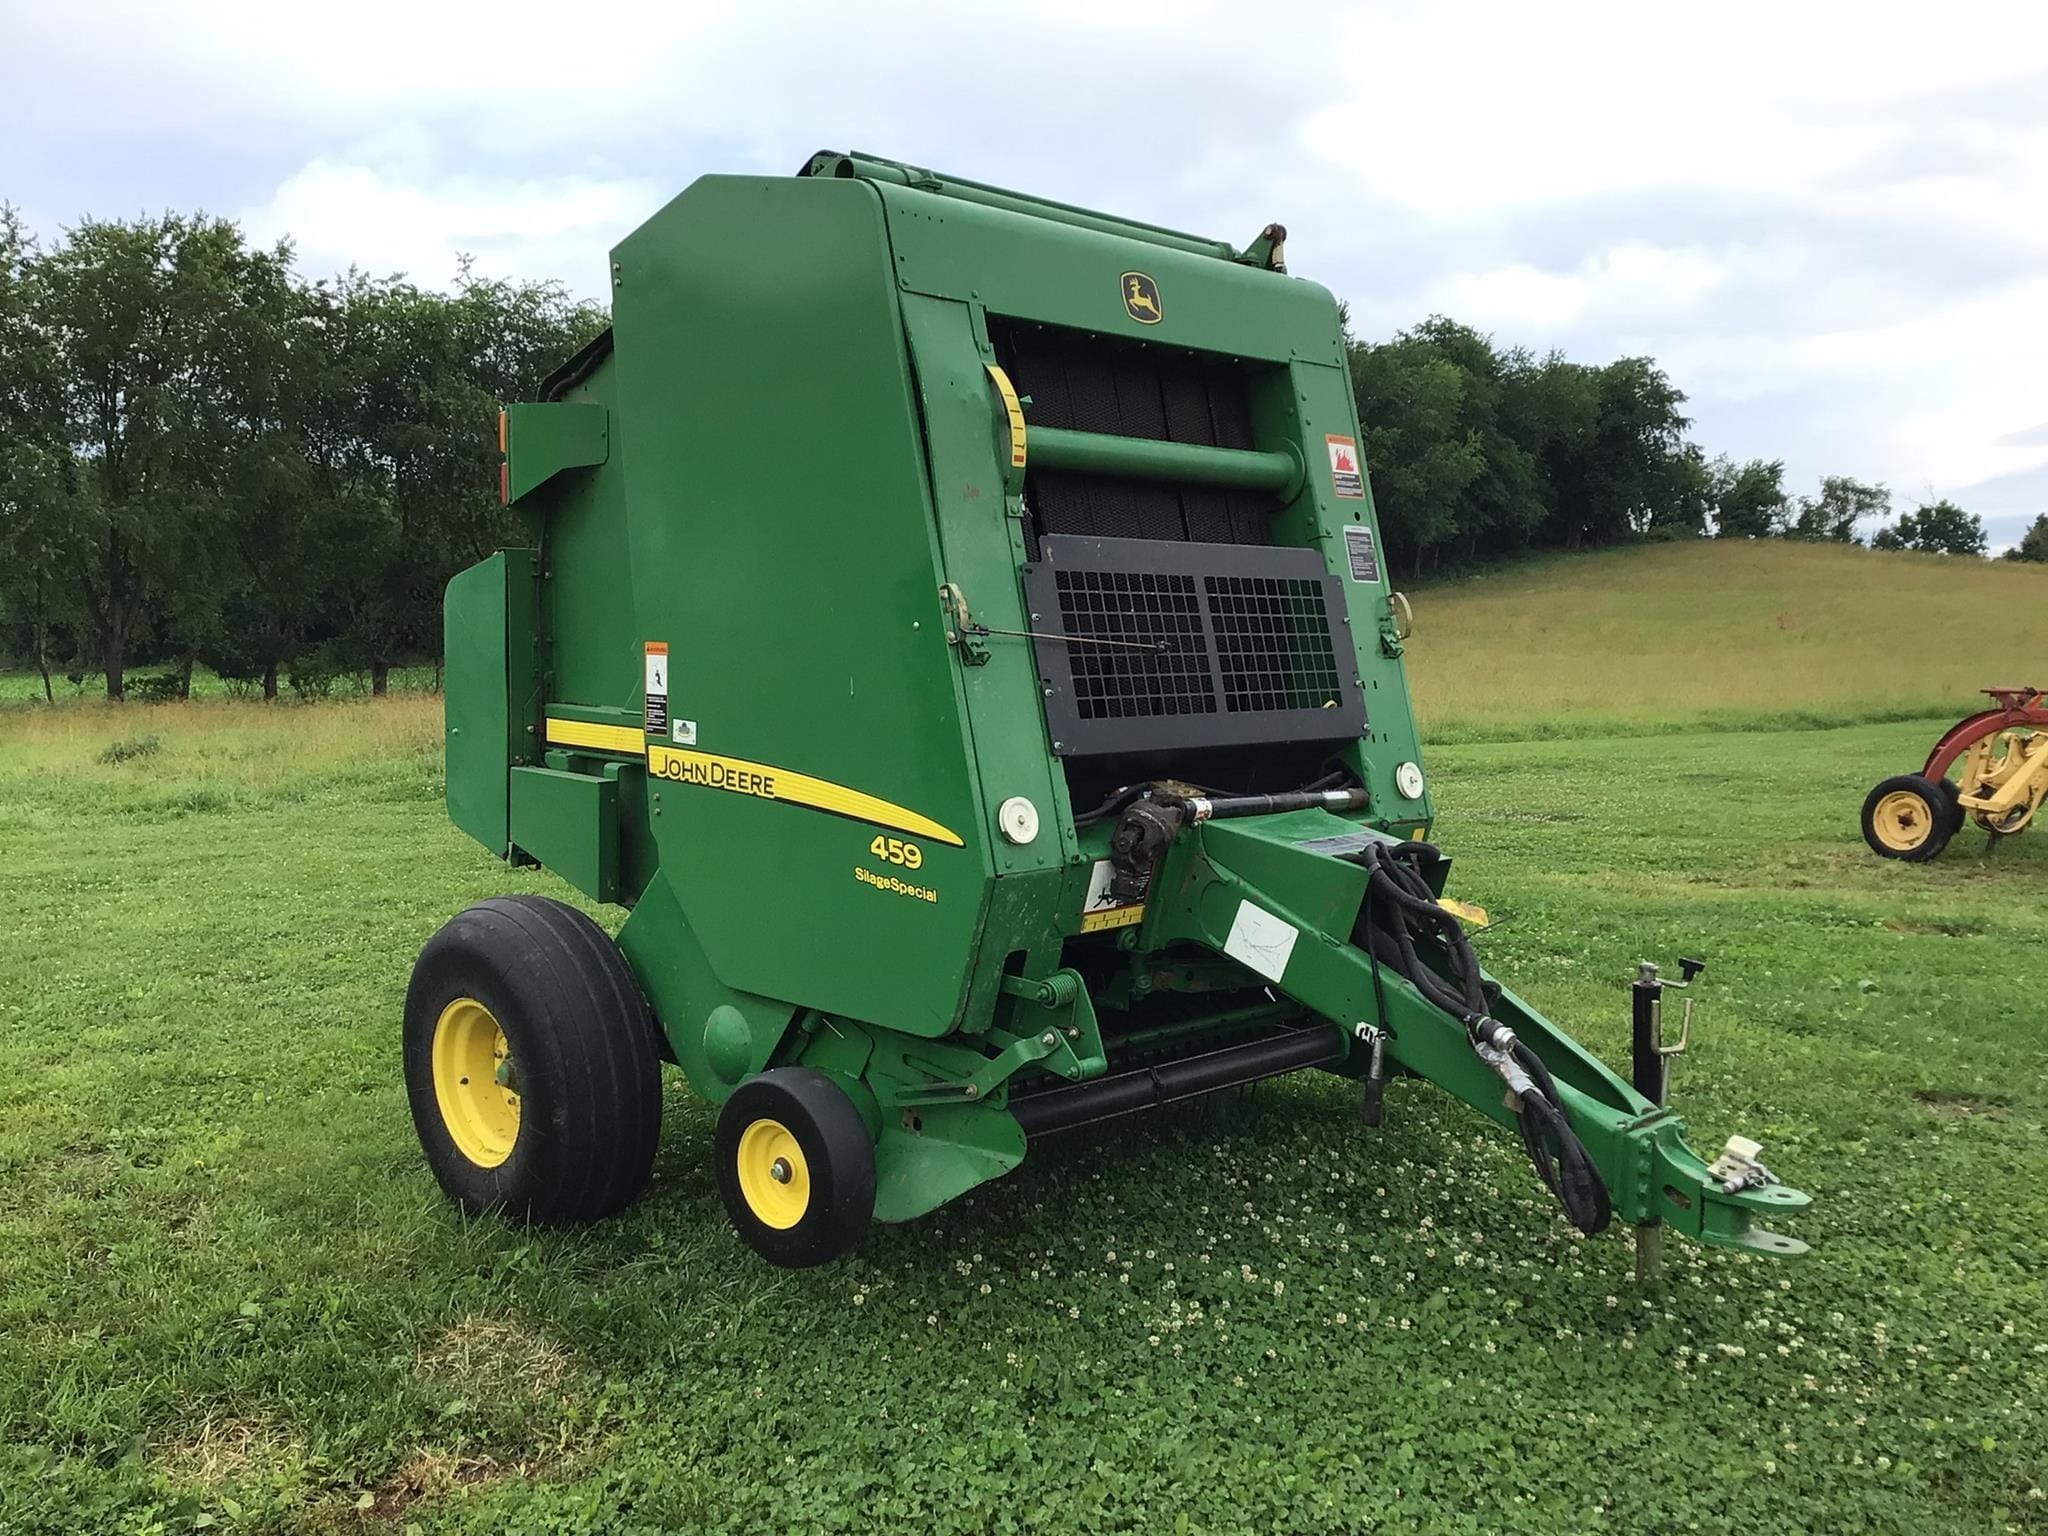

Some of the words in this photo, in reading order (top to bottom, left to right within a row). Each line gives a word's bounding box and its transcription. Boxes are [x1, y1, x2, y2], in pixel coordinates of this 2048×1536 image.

[659, 754, 707, 782] JOHN
[711, 762, 775, 795] DEERE
[870, 835, 923, 870] 459
[854, 866, 938, 903] SilageSpecial
